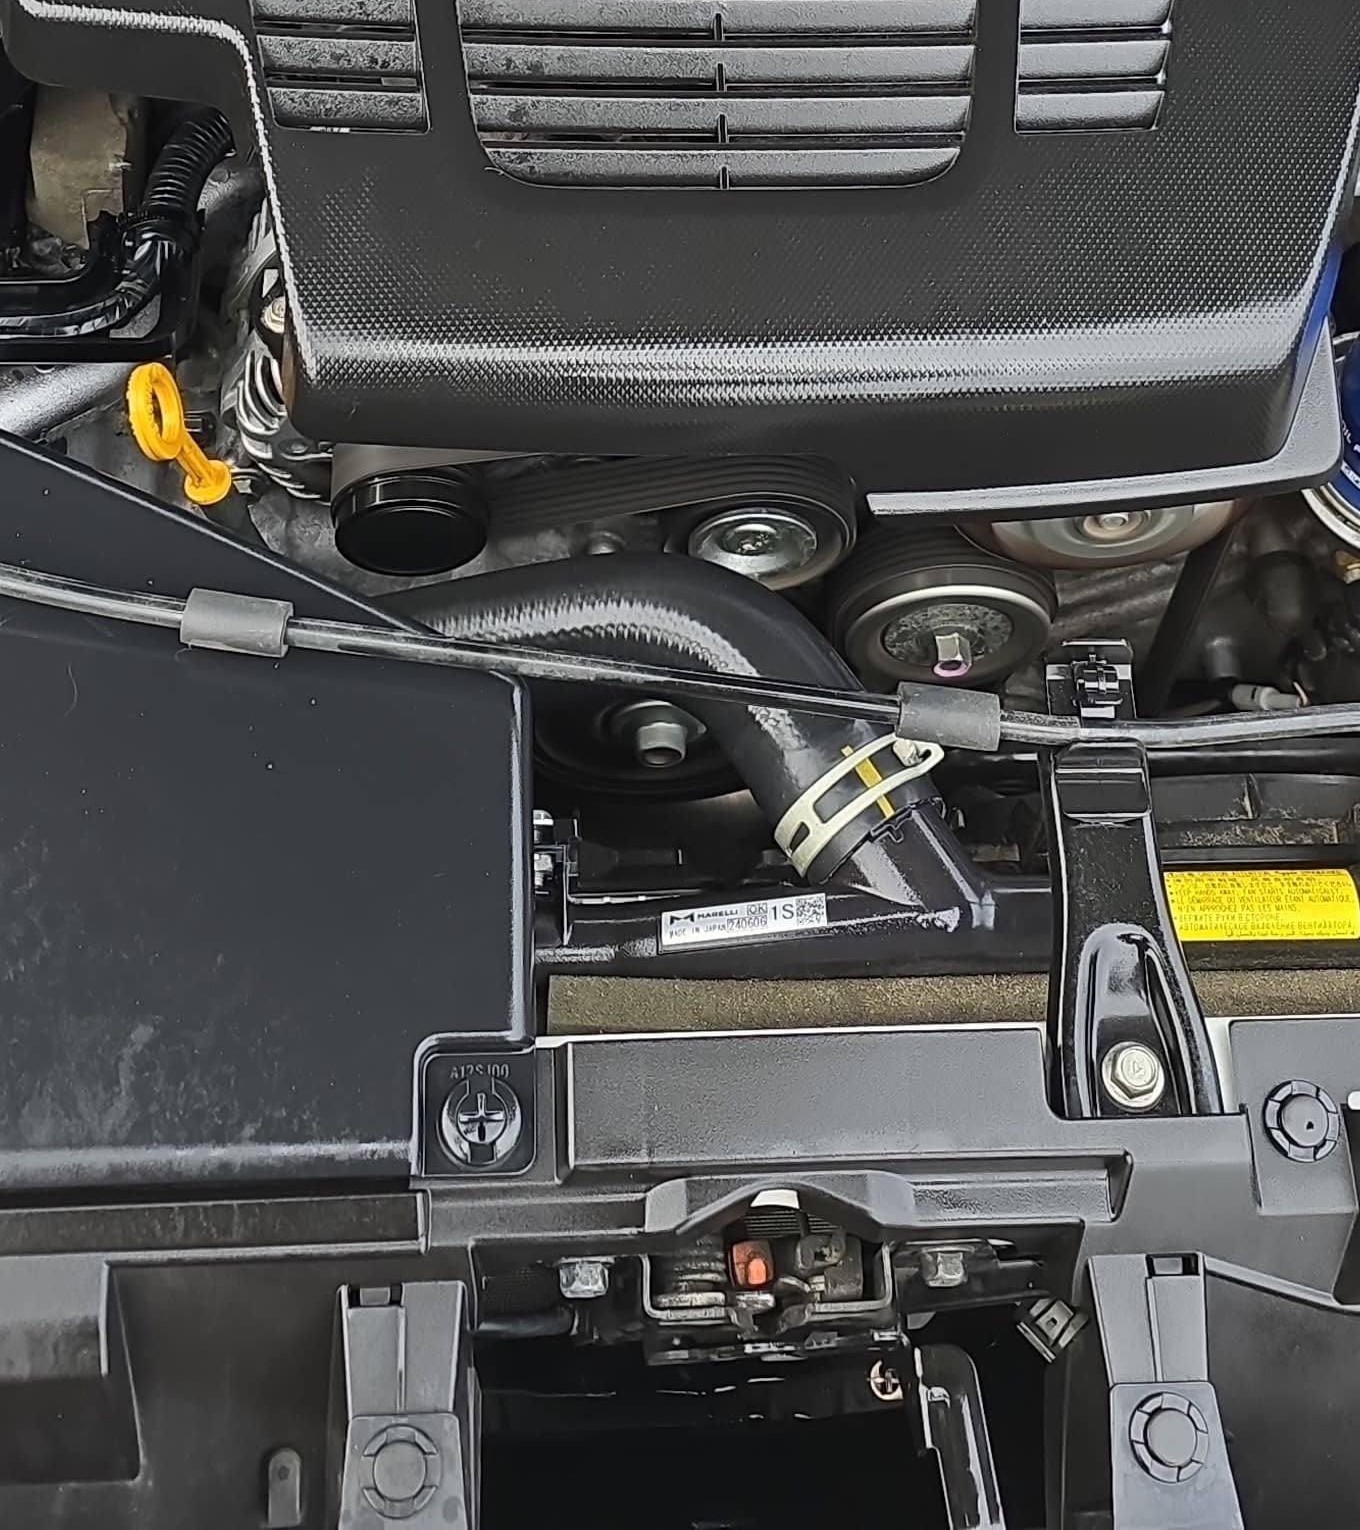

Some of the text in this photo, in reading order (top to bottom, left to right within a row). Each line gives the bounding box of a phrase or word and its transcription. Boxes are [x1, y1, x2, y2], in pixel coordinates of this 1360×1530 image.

[697, 908, 738, 919] MARELLI
[669, 927, 686, 938] MADE
[704, 923, 726, 935] JAPAN
